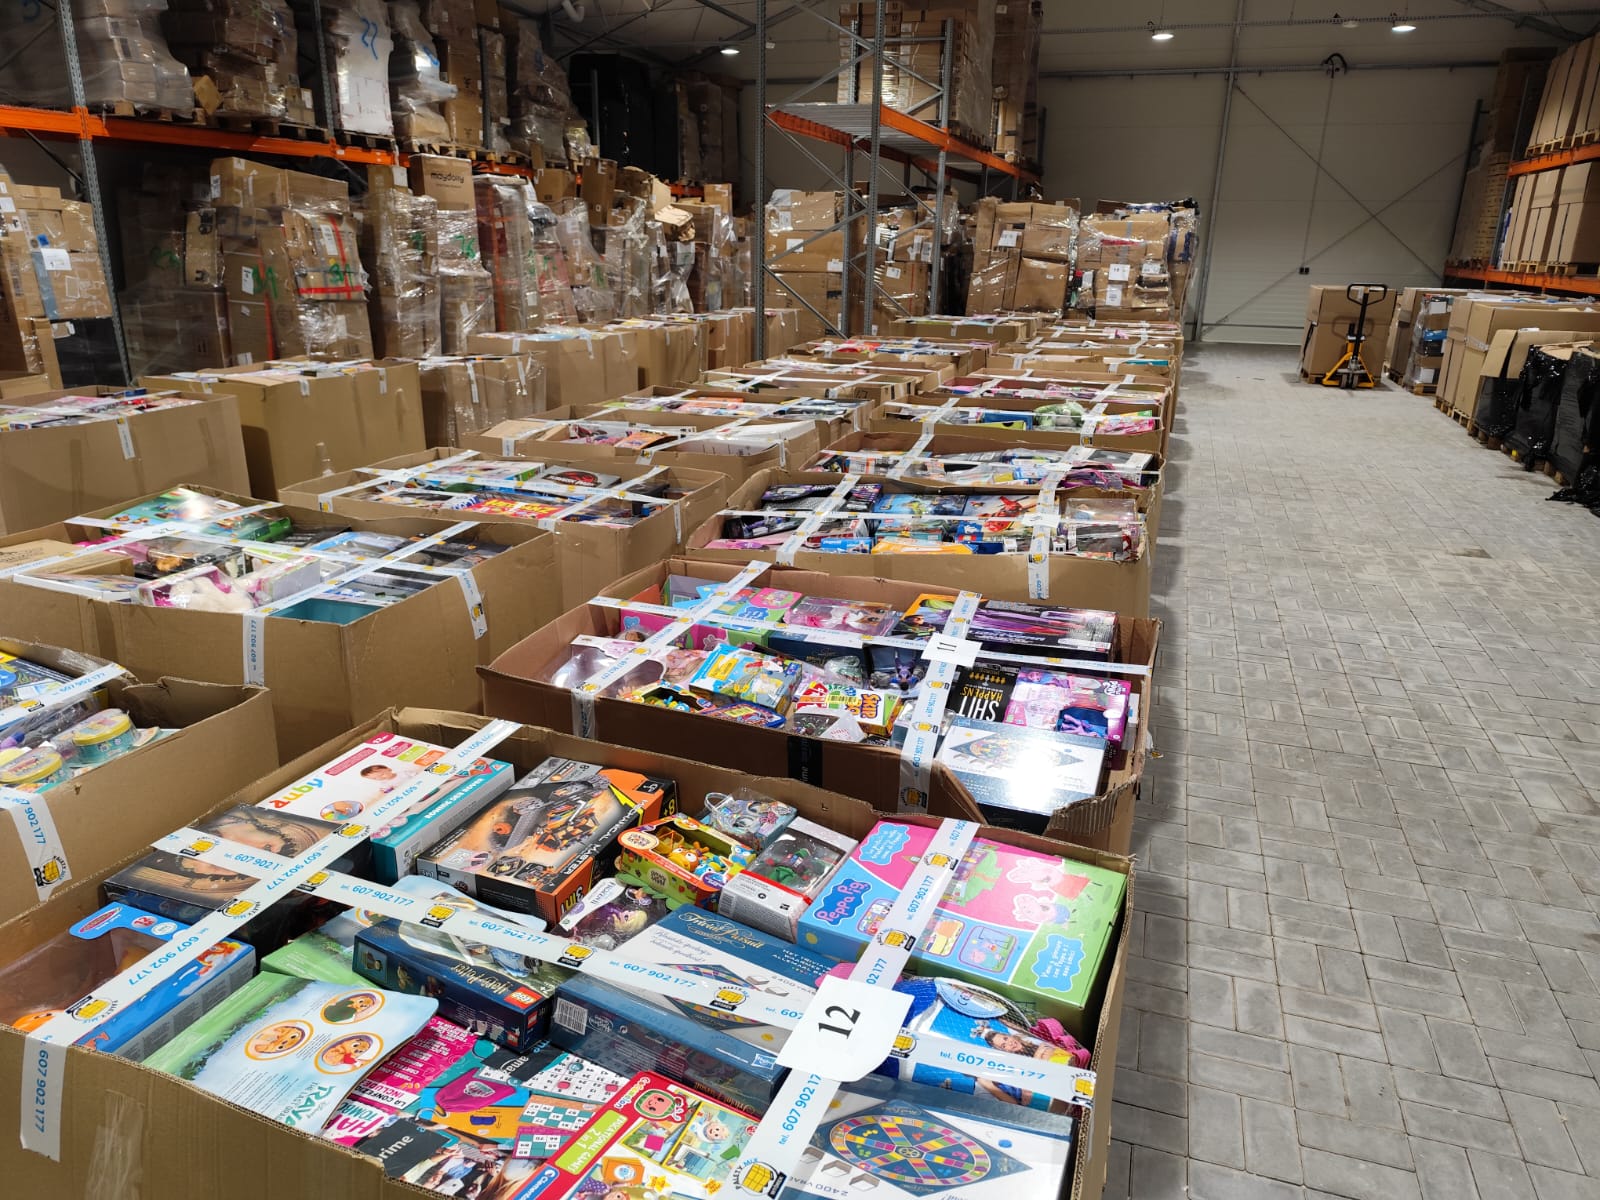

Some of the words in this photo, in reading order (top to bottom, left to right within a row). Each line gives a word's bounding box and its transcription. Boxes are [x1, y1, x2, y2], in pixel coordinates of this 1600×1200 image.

[961, 686, 1003, 702] HAPPENS
[860, 694, 881, 719] SKIP
[958, 695, 1000, 722] SHIT
[24, 807, 39, 828] 902
[30, 828, 46, 844] 177
[234, 853, 251, 863] 607
[254, 858, 273, 869] 902
[304, 852, 322, 864] 607
[563, 843, 601, 875] MASTER
[284, 864, 304, 877] 902
[267, 877, 285, 891] 177
[907, 897, 919, 913] 607
[915, 886, 927, 899] 902
[923, 875, 935, 887] 177
[352, 885, 373, 895] 607
[373, 891, 394, 902] 902
[394, 896, 414, 907] 177
[816, 896, 855, 922] Peppa
[837, 881, 869, 898] Pig
[679, 911, 726, 932] Trivial
[481, 920, 502, 933] 607
[527, 933, 548, 945] 177
[177, 935, 200, 952] 607
[151, 952, 177, 969] 902
[875, 958, 888, 973] 177
[129, 969, 153, 986] 177
[623, 963, 649, 974] 607
[649, 970, 672, 983] 902
[673, 976, 696, 988] 177
[780, 1008, 803, 1020] 607
[818, 1004, 861, 1041] 12
[37, 1050, 49, 1077] 607
[956, 1052, 984, 1066] 607
[808, 1073, 822, 1087] 17
[35, 1079, 47, 1106] 902
[795, 1086, 816, 1108] 902
[35, 1109, 45, 1133] 177
[782, 1108, 802, 1132] 607
[779, 1134, 790, 1146] tel.
